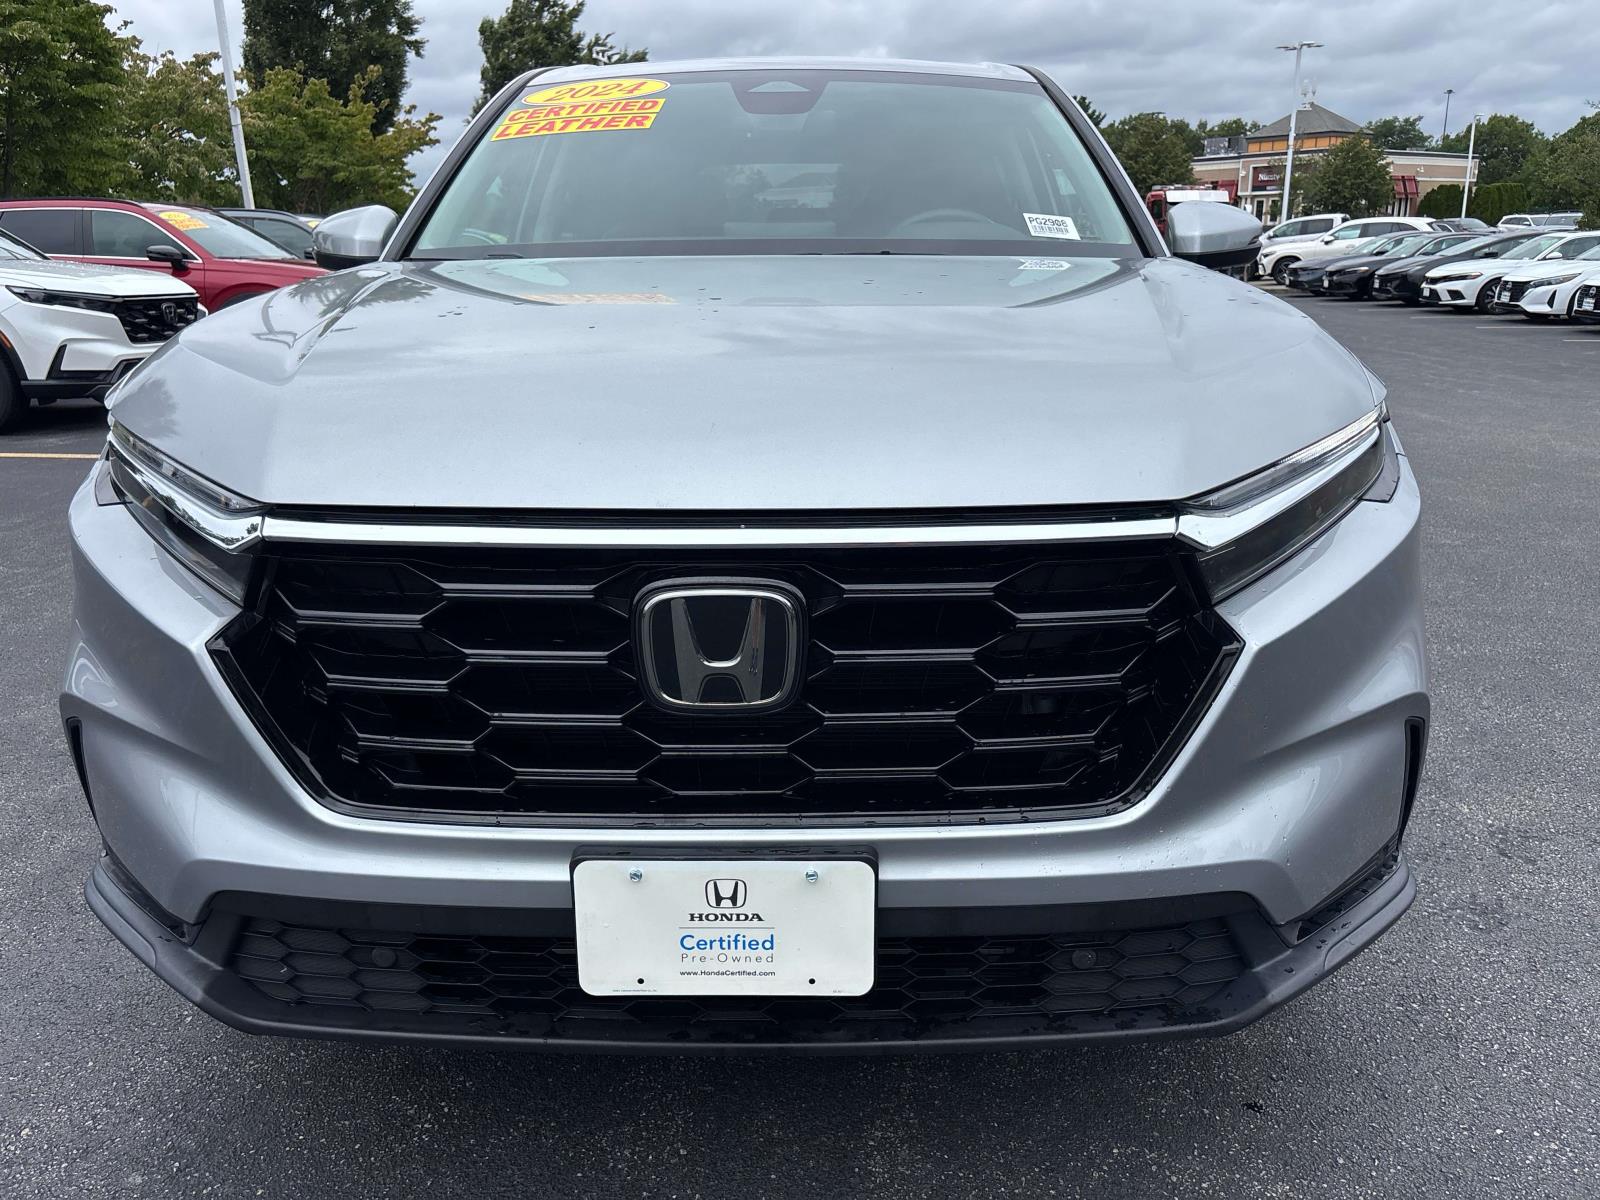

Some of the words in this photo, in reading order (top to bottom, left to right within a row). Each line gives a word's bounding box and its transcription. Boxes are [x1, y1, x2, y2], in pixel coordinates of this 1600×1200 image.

[544, 82, 647, 103] 2024
[507, 100, 660, 122] CERTIFIED
[495, 115, 651, 138] LEATHER
[689, 913, 764, 921] HONDA
[680, 934, 774, 950] Certified
[681, 953, 774, 963] Pre-Owned
